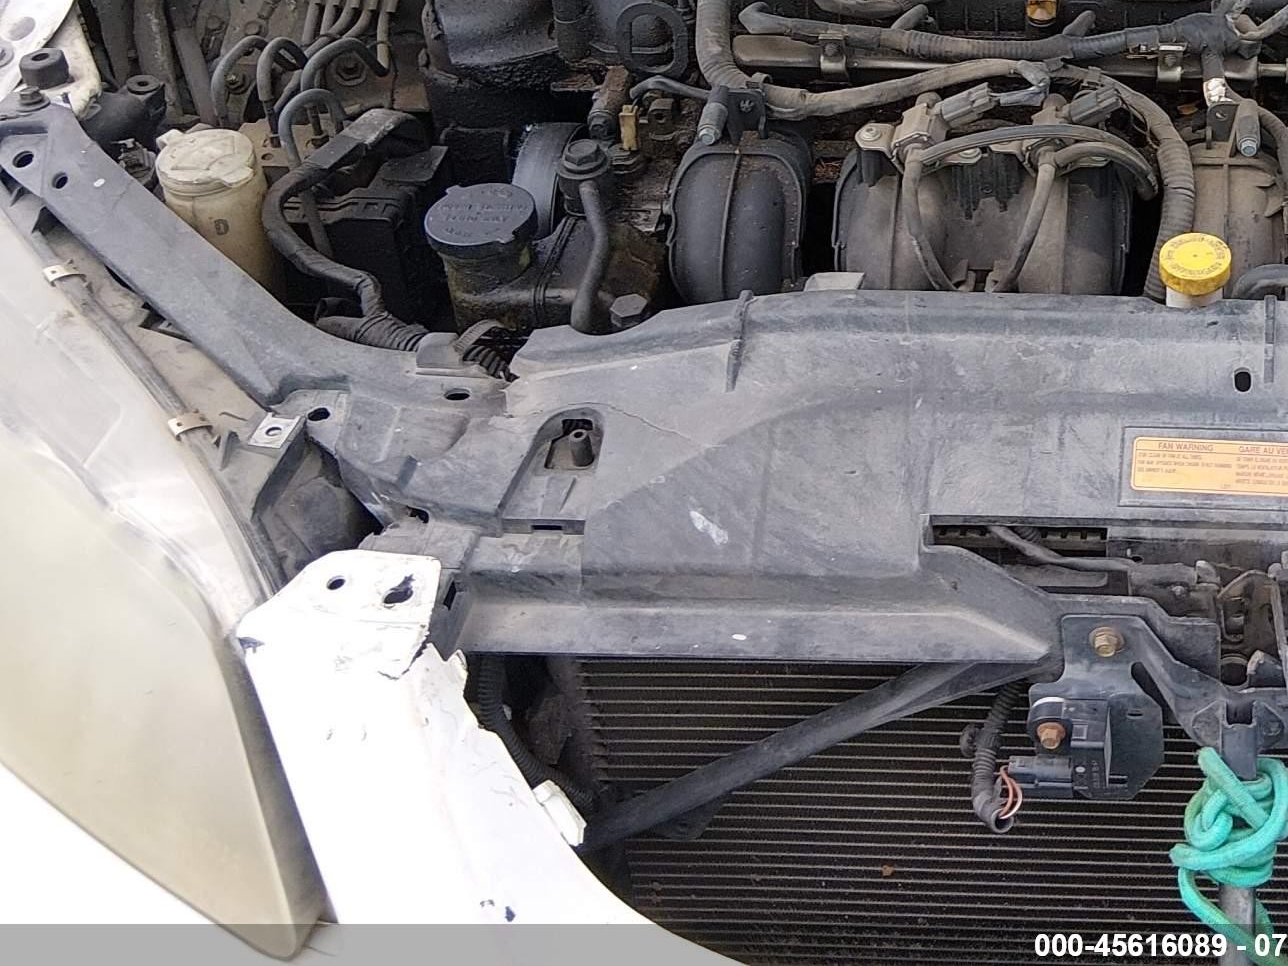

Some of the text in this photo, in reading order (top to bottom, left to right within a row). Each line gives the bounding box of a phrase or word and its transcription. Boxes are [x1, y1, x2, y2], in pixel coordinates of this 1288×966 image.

[1157, 441, 1214, 452] FAN WARNING
[1238, 445, 1261, 454] GARE
[1263, 447, 1275, 455] AU
